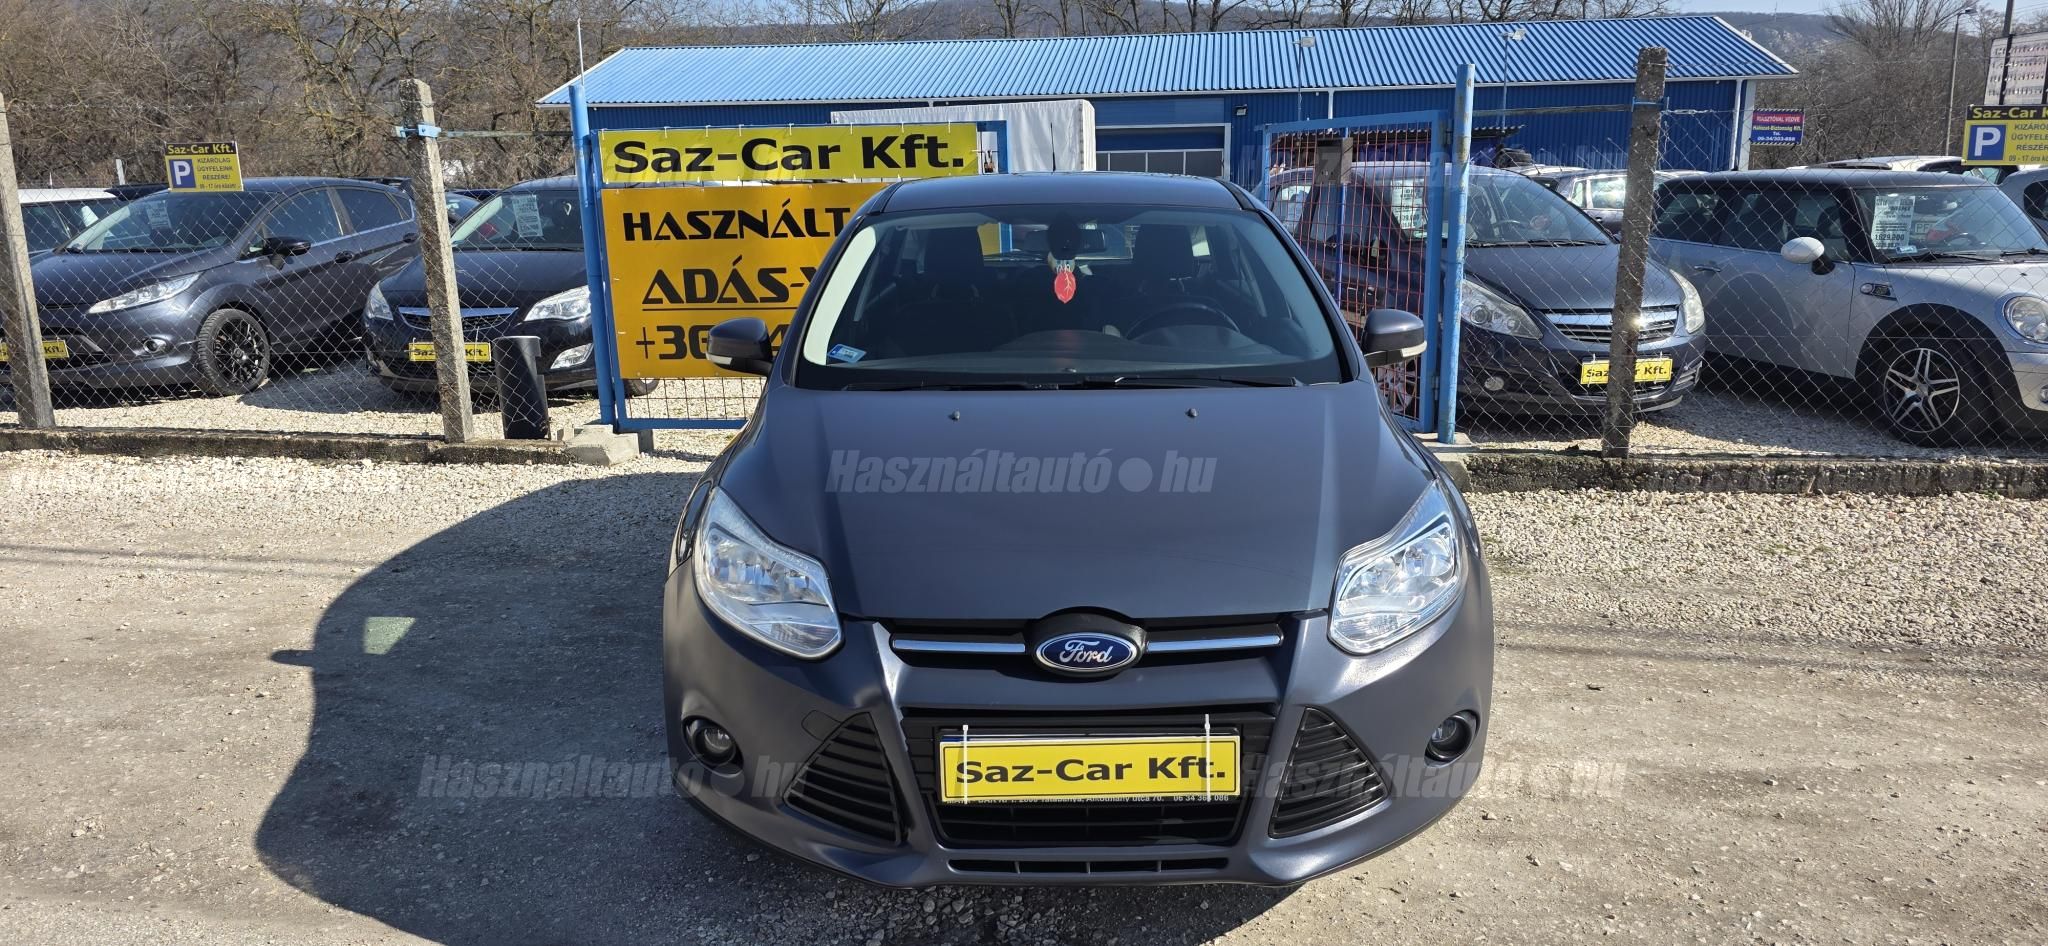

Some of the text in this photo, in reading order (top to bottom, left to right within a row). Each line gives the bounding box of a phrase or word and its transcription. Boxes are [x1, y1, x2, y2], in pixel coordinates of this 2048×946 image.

[1972, 107, 2037, 119] Saz-Car
[167, 143, 234, 155] Saz-Car Kft.
[613, 133, 964, 174] Saz-Car Kft.
[1974, 126, 2001, 157] P
[173, 160, 191, 186] P
[623, 198, 851, 241] HASZNÁLT
[1644, 366, 1667, 375] Kft.
[1059, 639, 1114, 663] Ford
[956, 755, 1226, 784] Saz-Car Kft.
